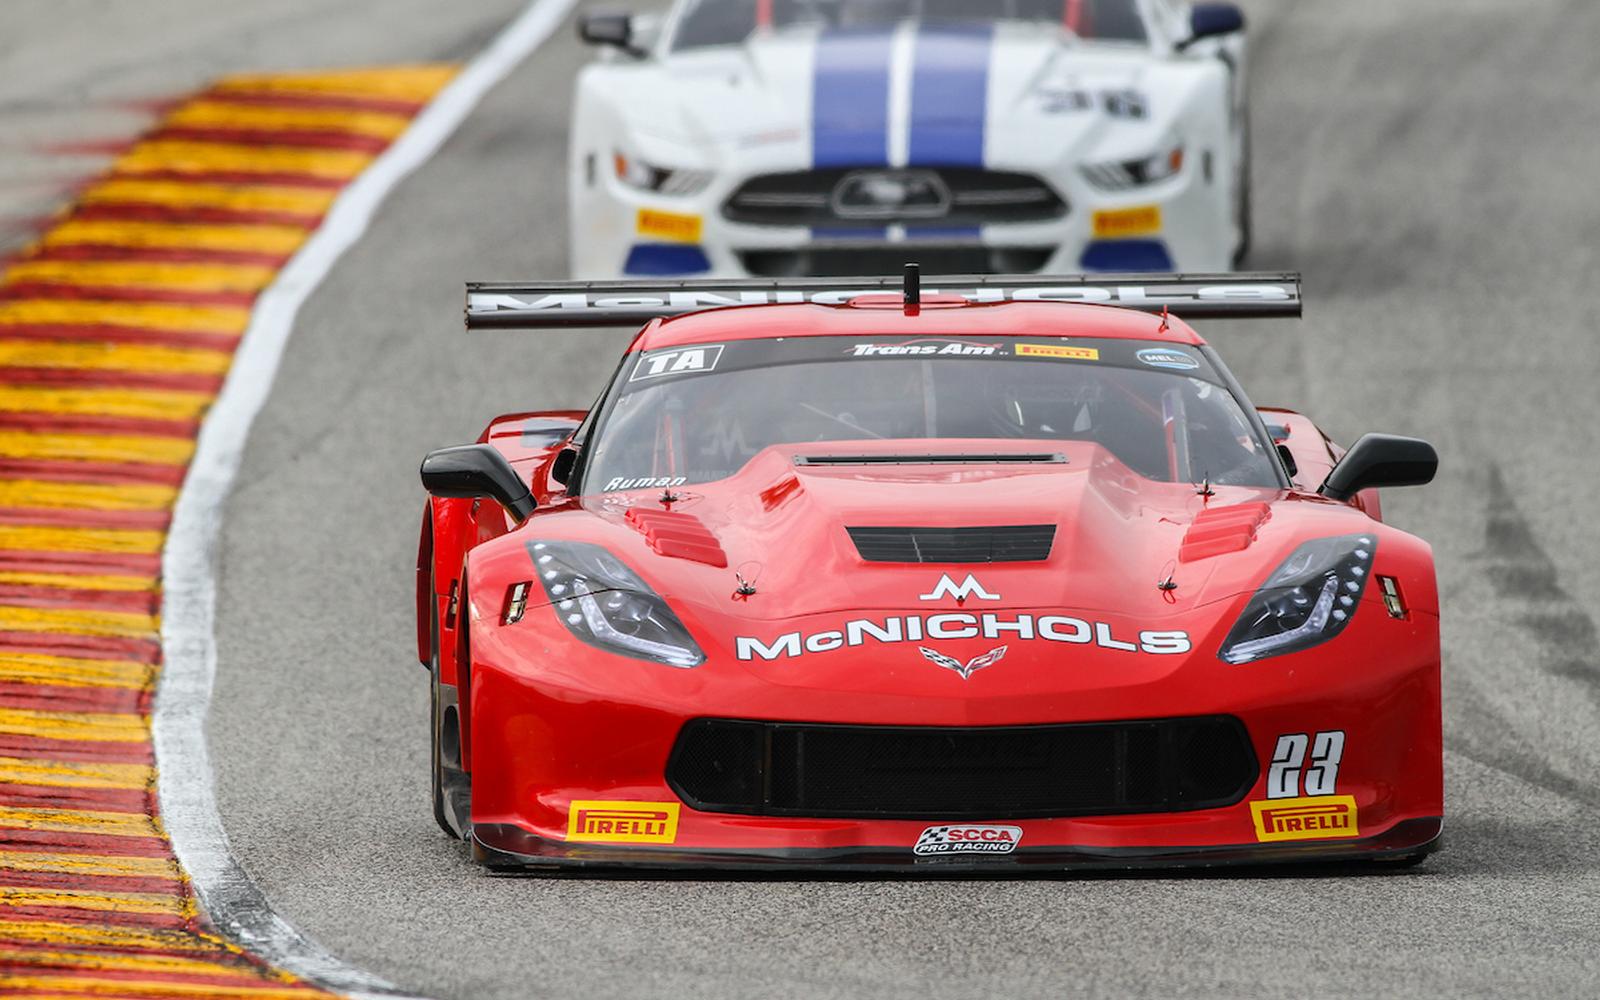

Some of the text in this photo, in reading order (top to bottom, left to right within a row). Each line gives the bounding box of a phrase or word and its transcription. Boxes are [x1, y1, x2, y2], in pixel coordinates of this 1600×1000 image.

[853, 344, 937, 355] Trans
[938, 343, 995, 355] Am
[648, 350, 704, 374] TA
[603, 477, 686, 491] Ruman
[735, 613, 1193, 661] McNICHOLS
[1267, 730, 1345, 799] 23
[576, 809, 668, 835] PIRELLI
[1261, 804, 1349, 833] PIRELLI
[918, 842, 1010, 852] PRO RACING
[947, 829, 1014, 841] SCCA
